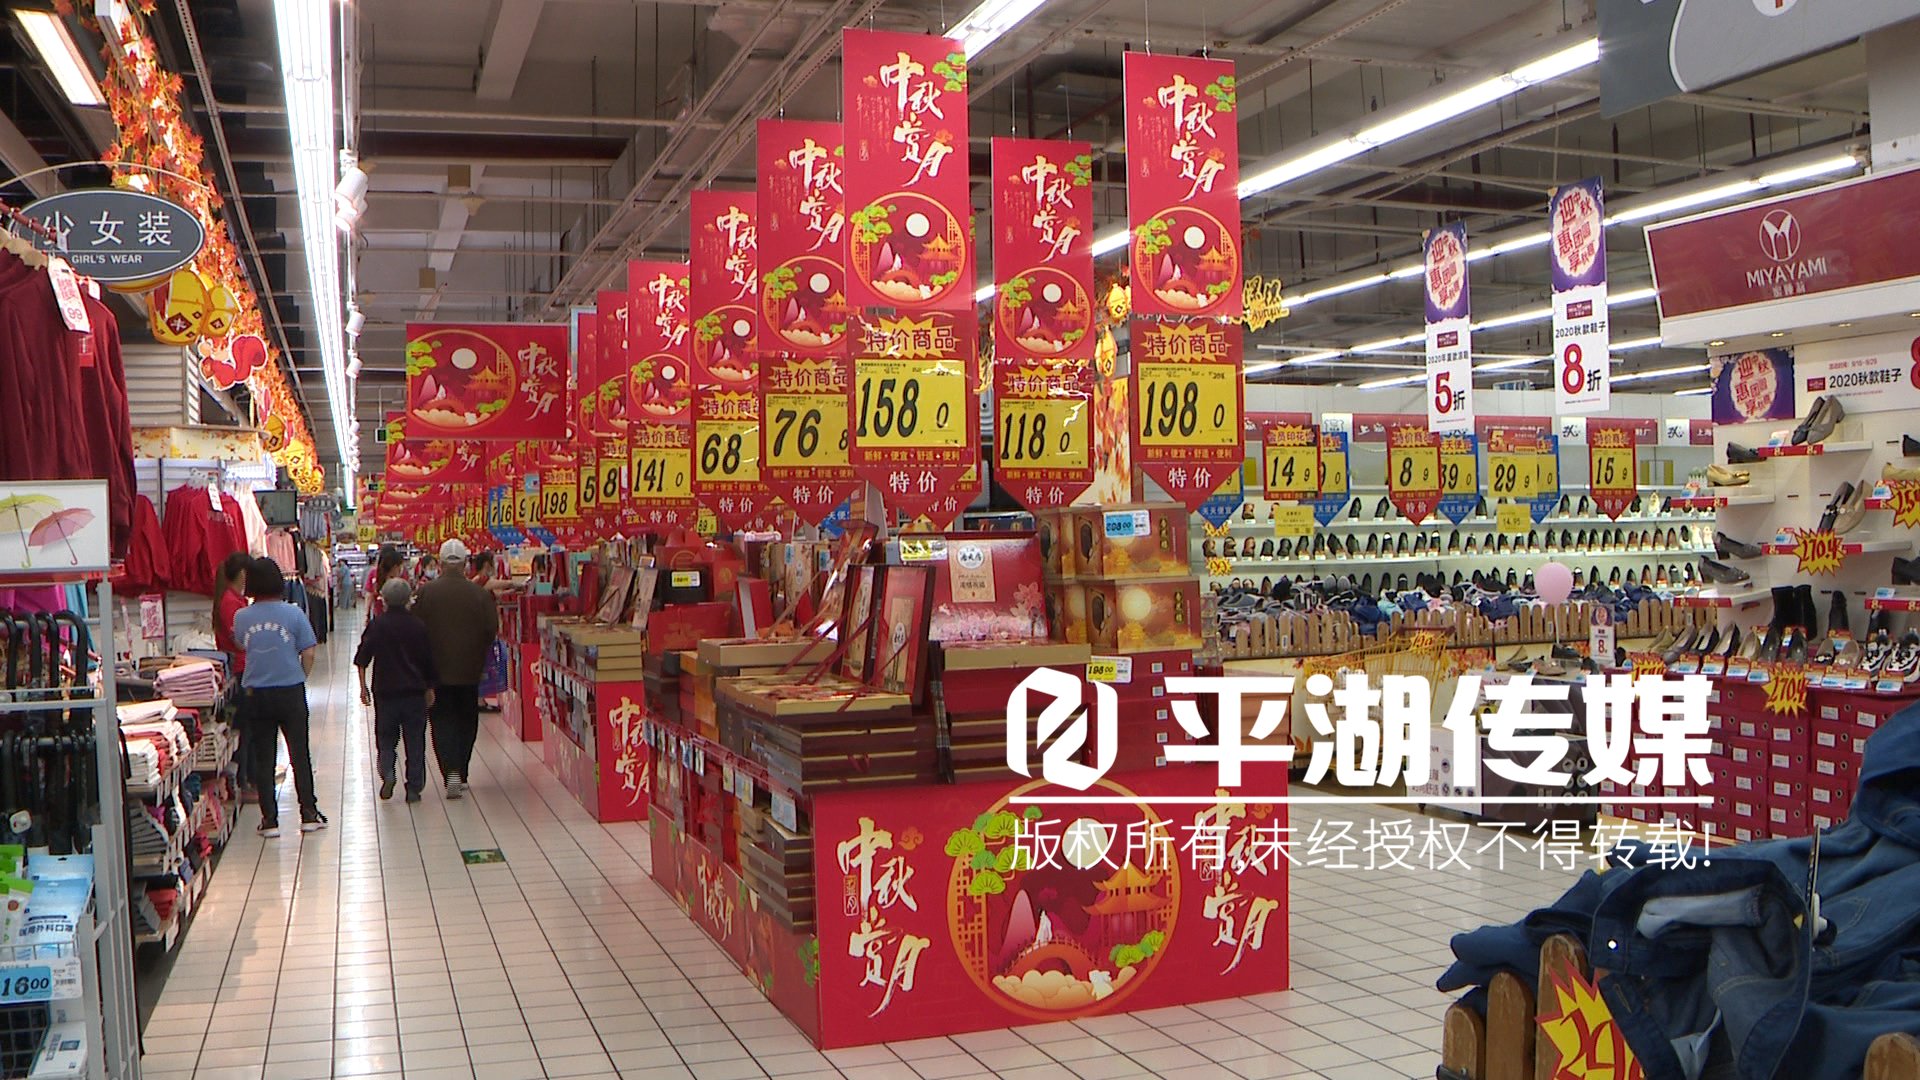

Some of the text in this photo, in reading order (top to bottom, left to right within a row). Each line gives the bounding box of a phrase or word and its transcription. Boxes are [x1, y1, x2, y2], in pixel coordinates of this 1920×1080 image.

[880, 51, 954, 188] 中秋赏月
[1157, 74, 1226, 202] 中秋赏月
[1021, 154, 1081, 263] 中秋赏月
[43, 210, 172, 246] 少女装
[71, 253, 143, 265] GIRL'S WEAR
[1746, 256, 1828, 289] MIYAYAMI
[864, 327, 957, 352] 特价商品
[1147, 334, 1227, 357] 特价商品
[774, 367, 847, 389] 特价商品
[1829, 368, 1902, 389] 2020秋款鞋子
[889, 470, 938, 494] 特价
[1167, 467, 1212, 489] 特价
[718, 497, 754, 513] 特价
[793, 485, 834, 504] 特价
[1025, 485, 1064, 505] 特价
[836, 816, 931, 1019] 中秋赏月
